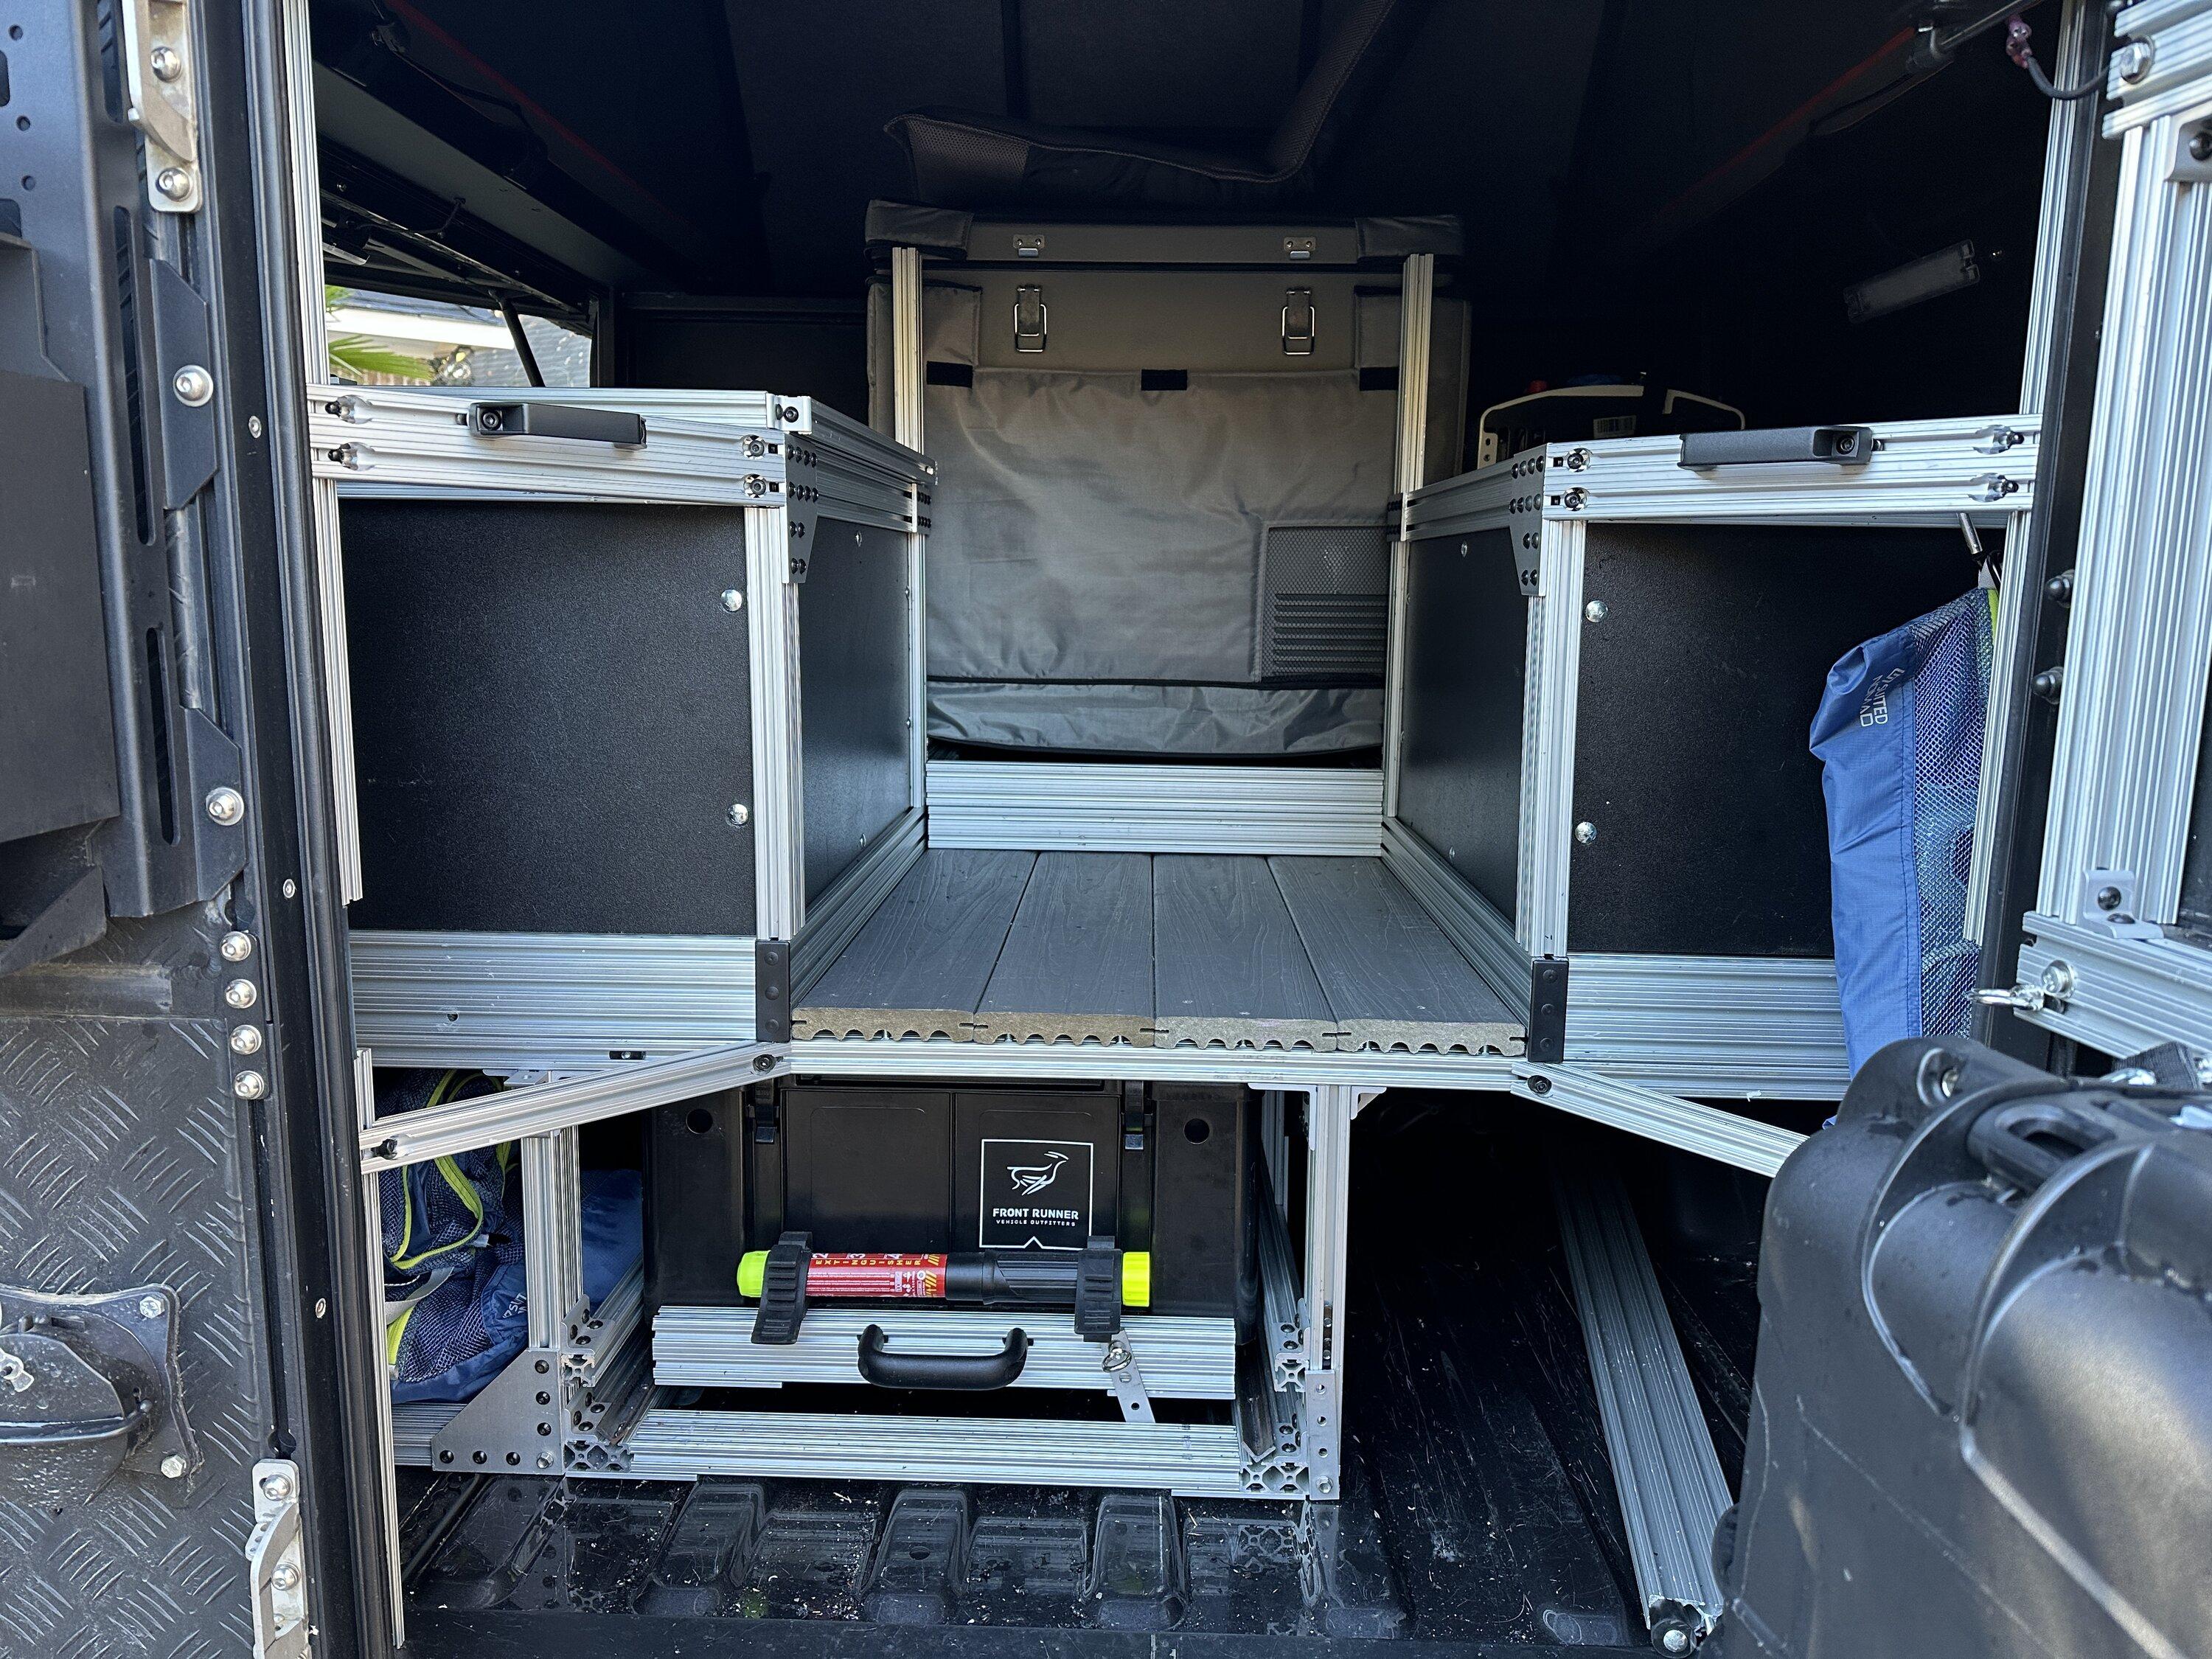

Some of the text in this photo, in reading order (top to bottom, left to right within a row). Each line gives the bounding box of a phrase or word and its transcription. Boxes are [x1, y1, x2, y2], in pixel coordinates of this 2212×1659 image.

[1873, 684, 1888, 725] SUITED
[992, 1208, 1079, 1220] FRONT RUNNER
[509, 1293, 526, 1312] SUIT
